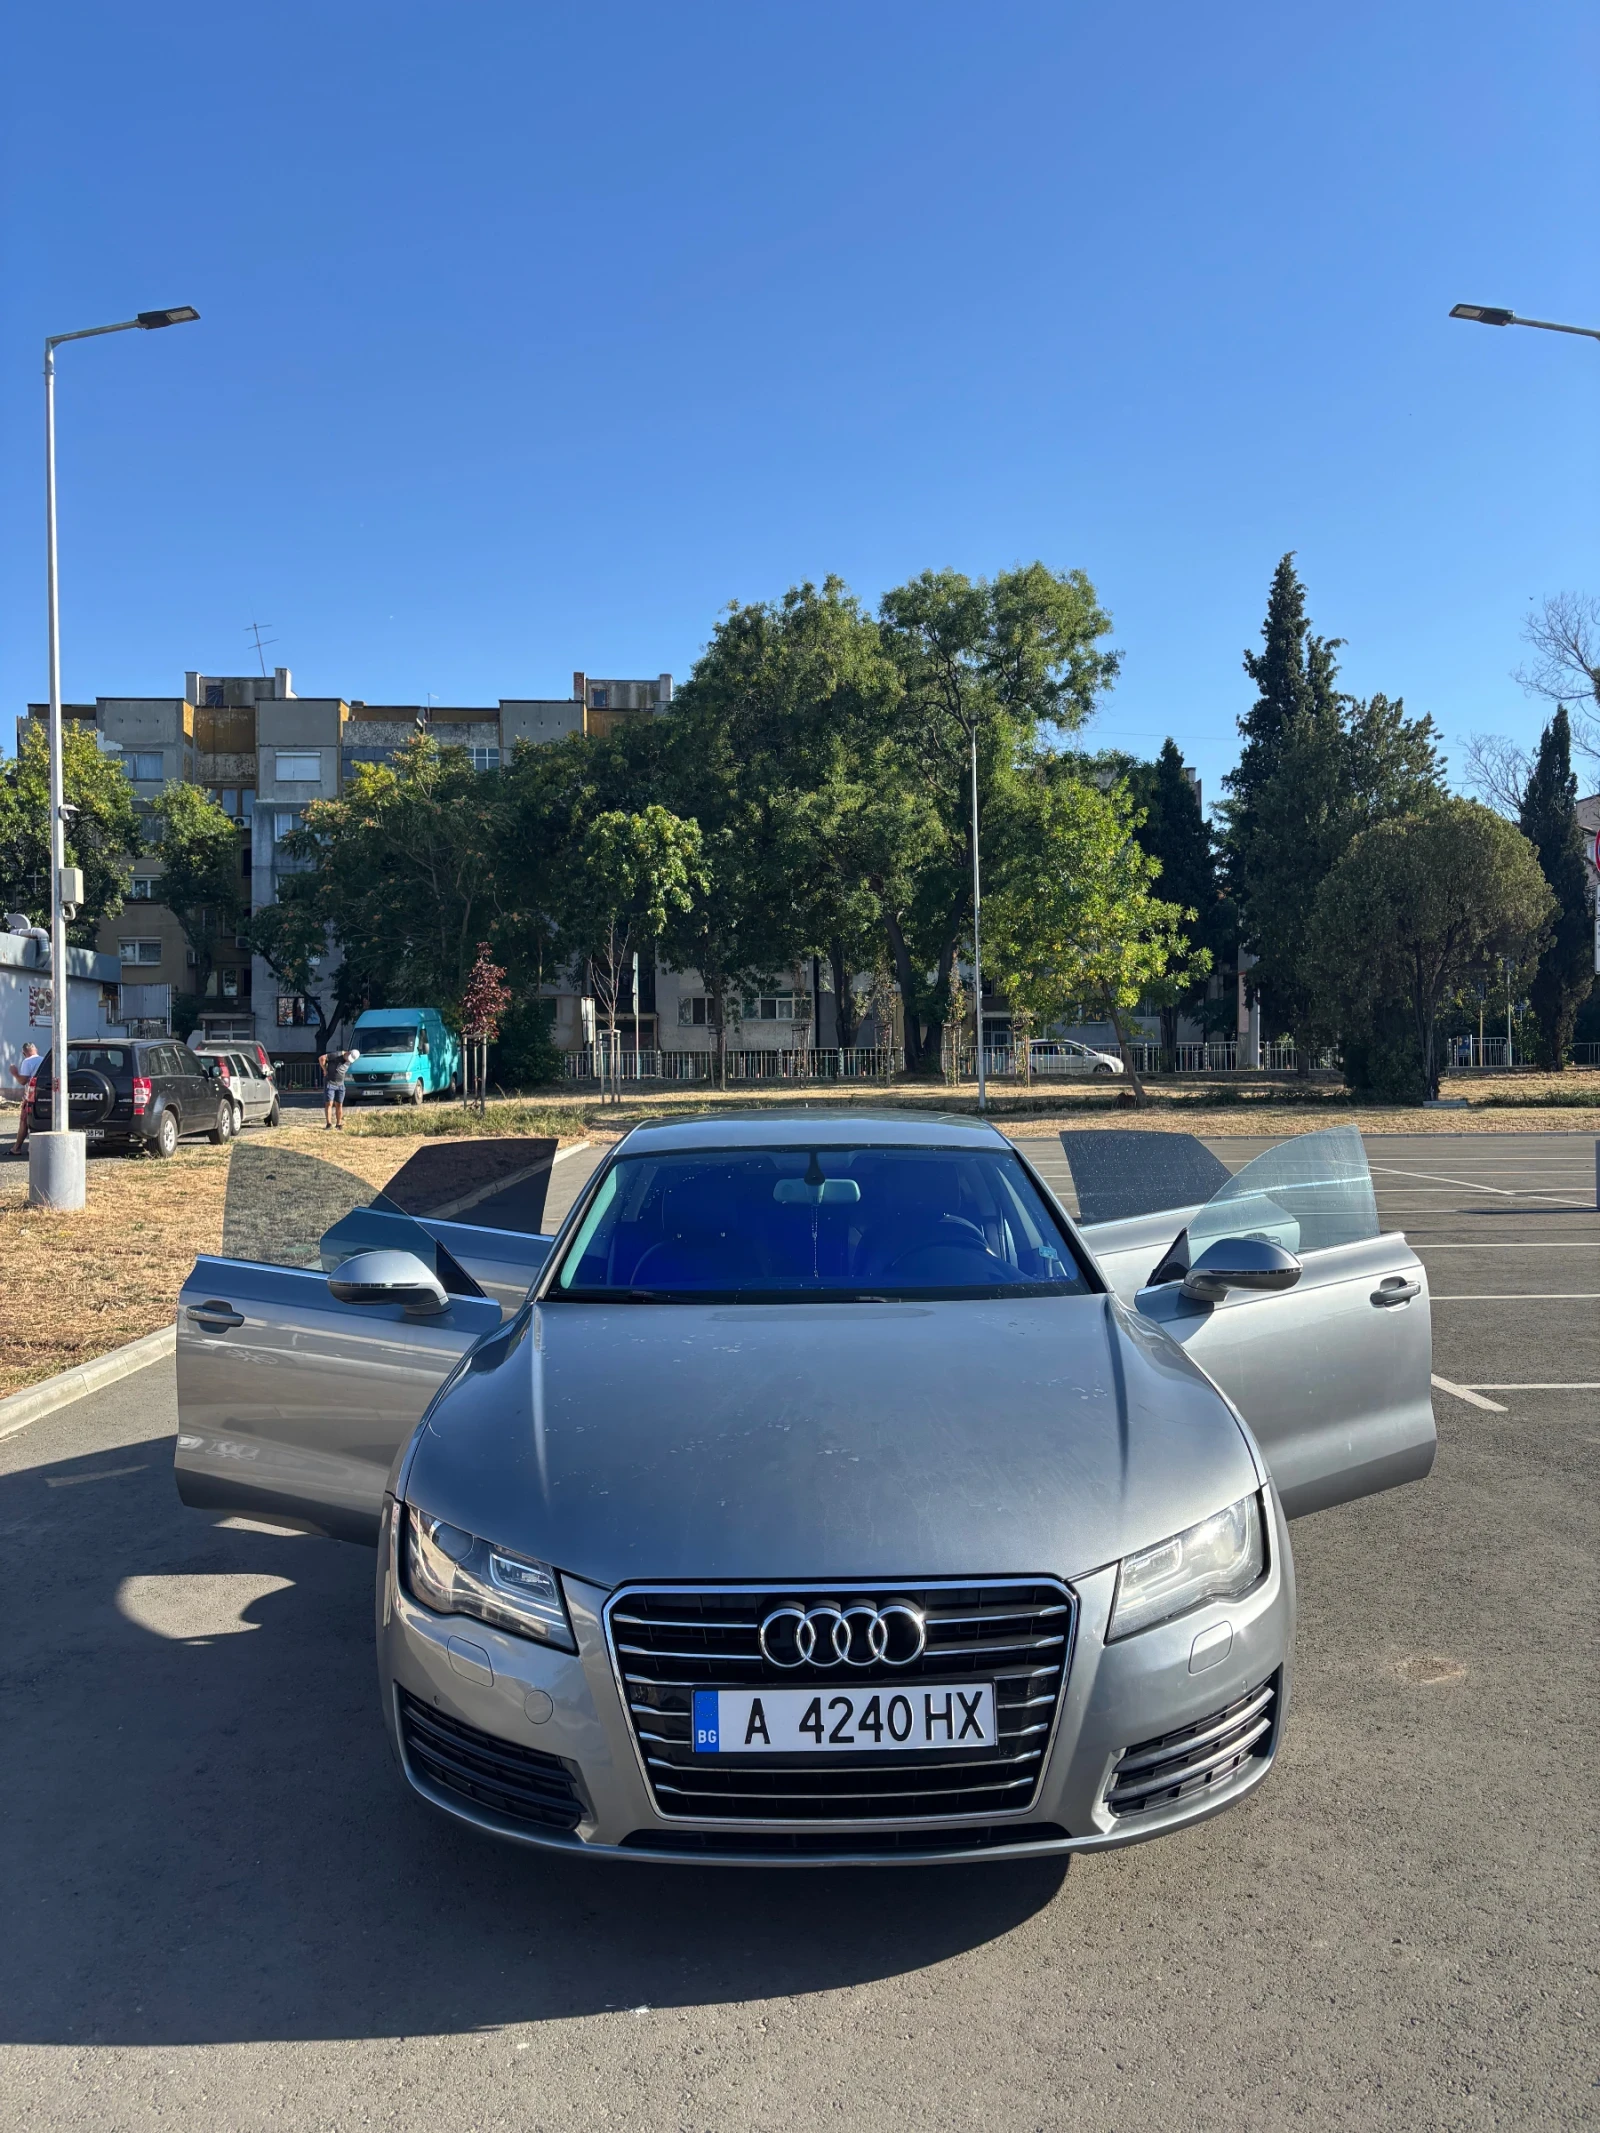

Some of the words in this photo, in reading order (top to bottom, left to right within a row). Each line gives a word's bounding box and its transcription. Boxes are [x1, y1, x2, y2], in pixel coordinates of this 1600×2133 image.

[67, 1092, 103, 1101] UZUKI
[744, 1698, 771, 1744] A
[798, 1694, 913, 1744] 4240
[924, 1690, 985, 1741] HX
[698, 1729, 717, 1744] BG
